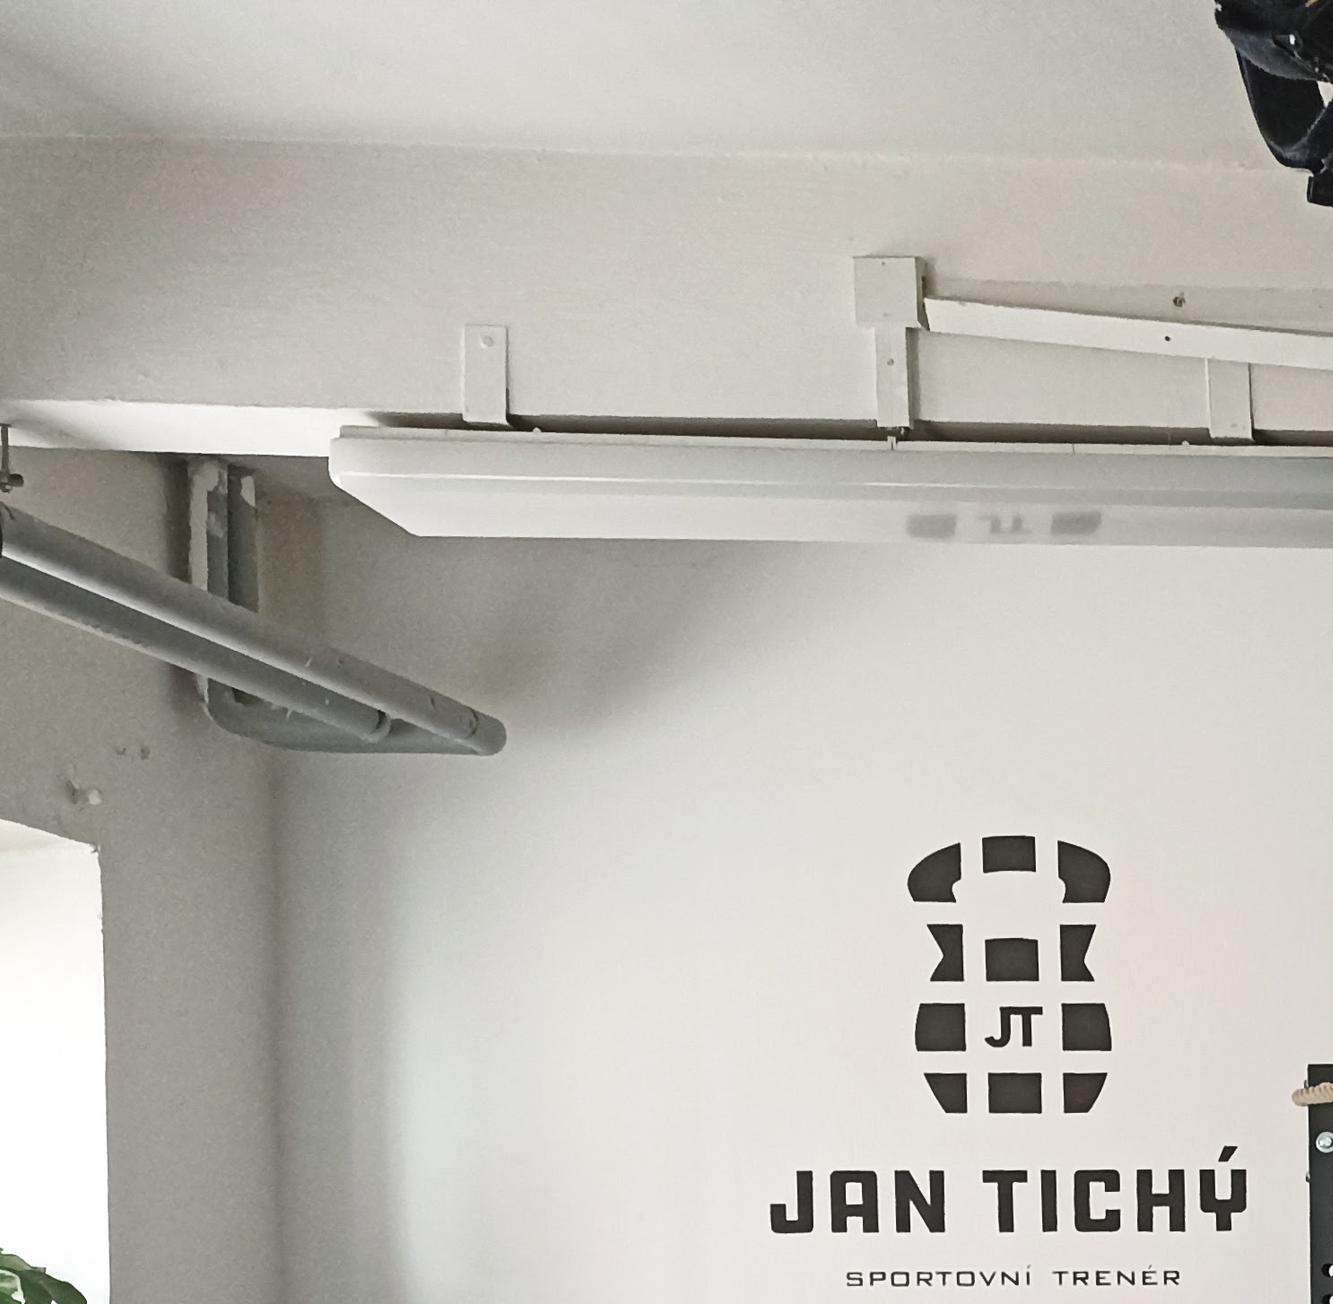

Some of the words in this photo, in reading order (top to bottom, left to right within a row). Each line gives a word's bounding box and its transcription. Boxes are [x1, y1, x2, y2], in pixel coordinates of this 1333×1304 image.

[984, 1006, 1043, 1048] JT
[769, 1169, 946, 1234] JAN
[982, 1145, 1248, 1233] TICHÝ
[845, 1264, 1034, 1288] SPORTOVNÍ
[1052, 1264, 1182, 1288] TRENÉR
